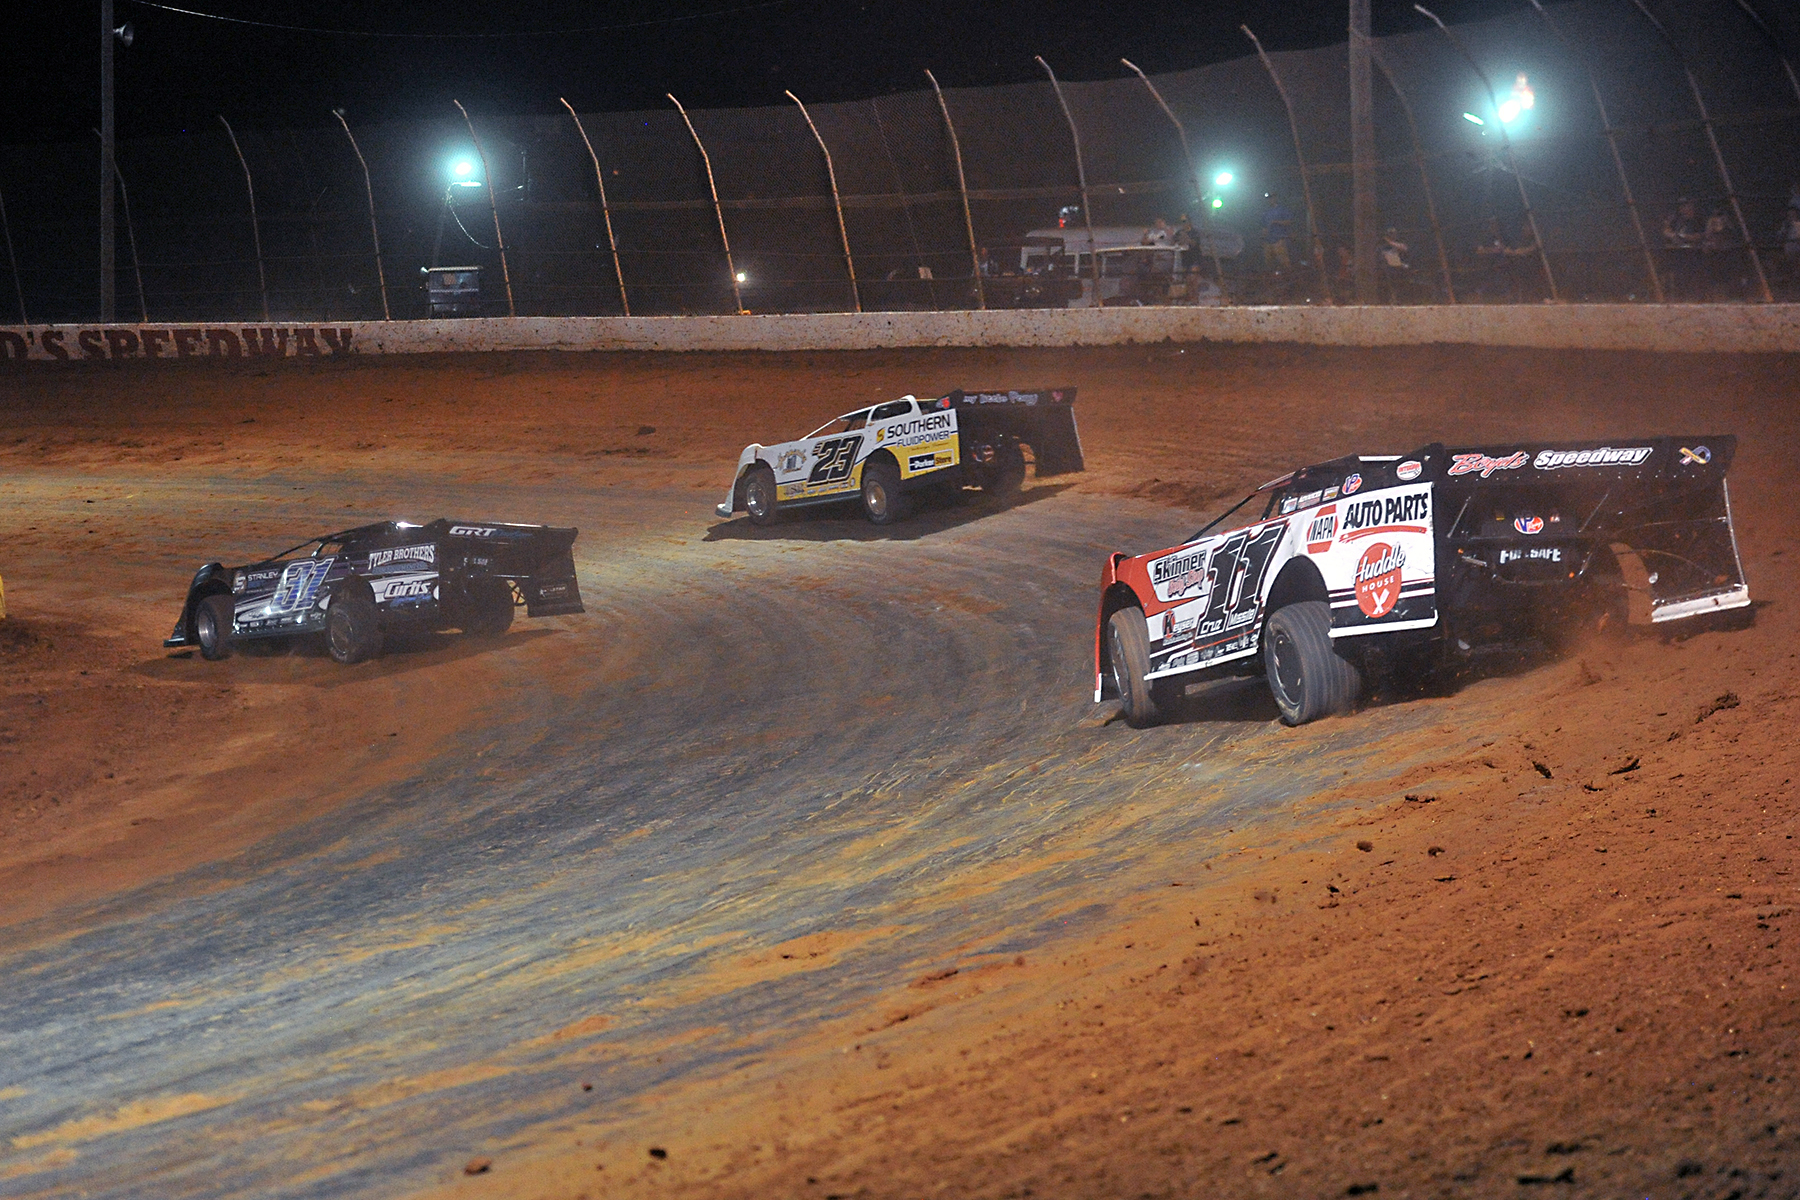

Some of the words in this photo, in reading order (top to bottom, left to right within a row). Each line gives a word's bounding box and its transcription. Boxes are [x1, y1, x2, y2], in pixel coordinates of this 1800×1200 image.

[79, 328, 352, 360] SPEEDWAY
[887, 414, 951, 439] SOUTHERN
[897, 430, 950, 448] FLUIDPOWER
[808, 434, 864, 486] 23
[1534, 447, 1652, 470] Speedway
[1343, 500, 1382, 530] AUTO
[1385, 492, 1429, 524] PARTS
[449, 526, 497, 536] GRT
[1310, 516, 1334, 541] NAPA
[368, 550, 393, 570] TYLER
[393, 545, 435, 563] BROTHERS
[1154, 551, 1206, 581] Skinner
[1352, 543, 1407, 586] Huddle
[248, 571, 279, 581] STANLEY
[271, 556, 336, 612] 31
[1195, 519, 1289, 640] 11
[1362, 575, 1395, 593] HOUSE
